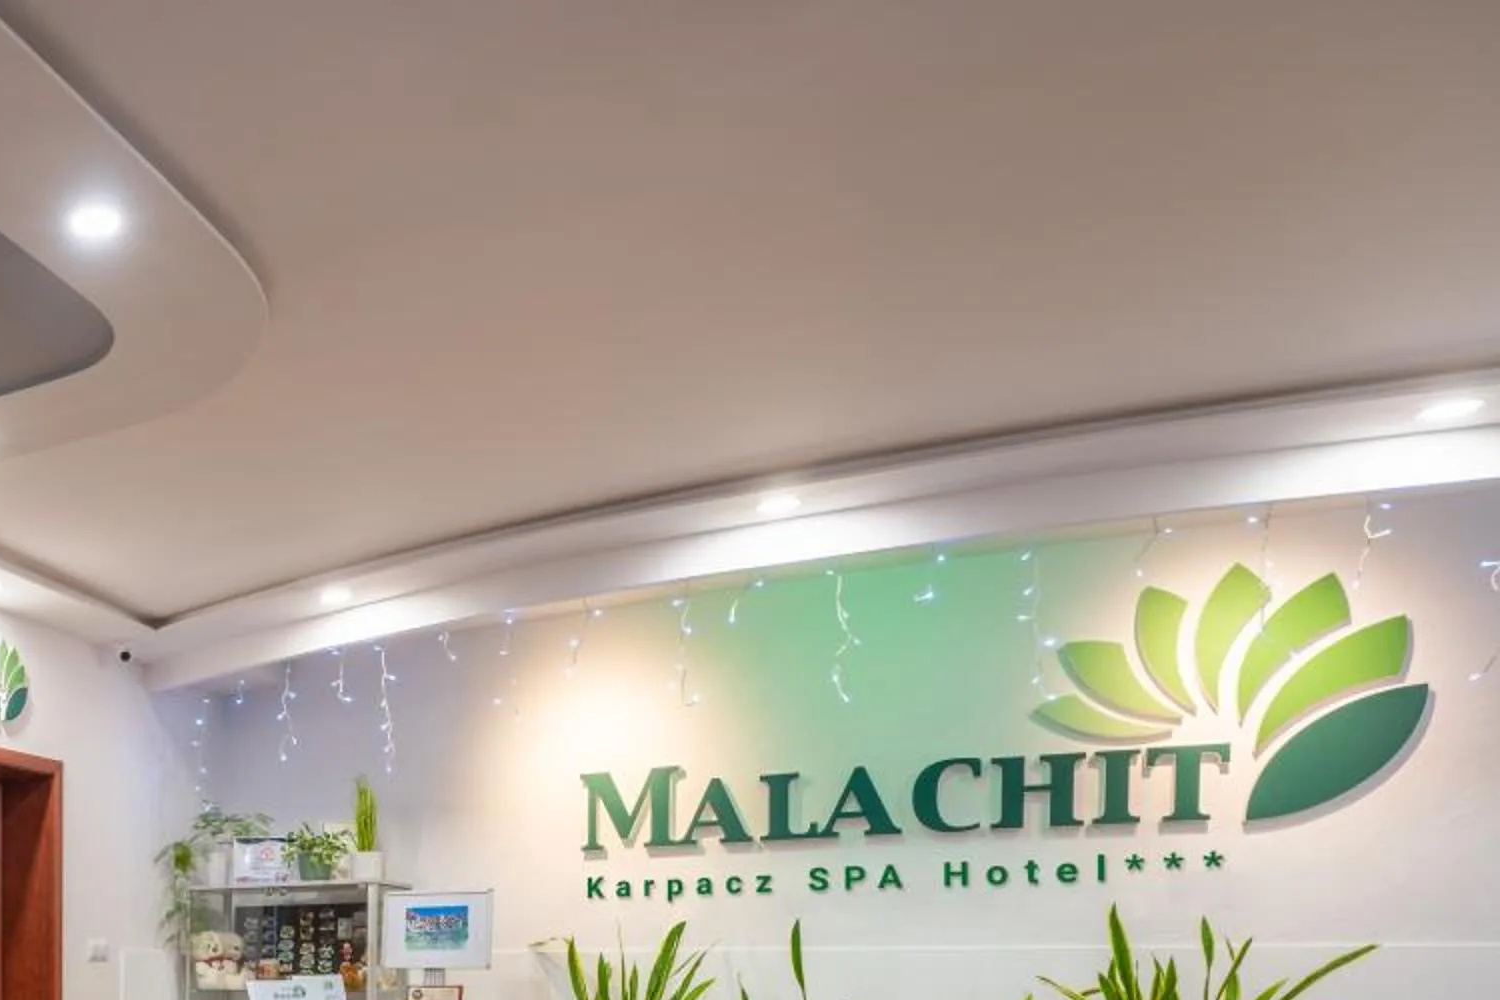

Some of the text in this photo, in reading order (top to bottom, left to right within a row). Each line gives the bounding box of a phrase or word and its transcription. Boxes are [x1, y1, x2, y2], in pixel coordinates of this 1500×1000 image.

[580, 743, 1231, 851] MALACHIT
[586, 875, 773, 902] Karpacz
[808, 863, 903, 892] SPA
